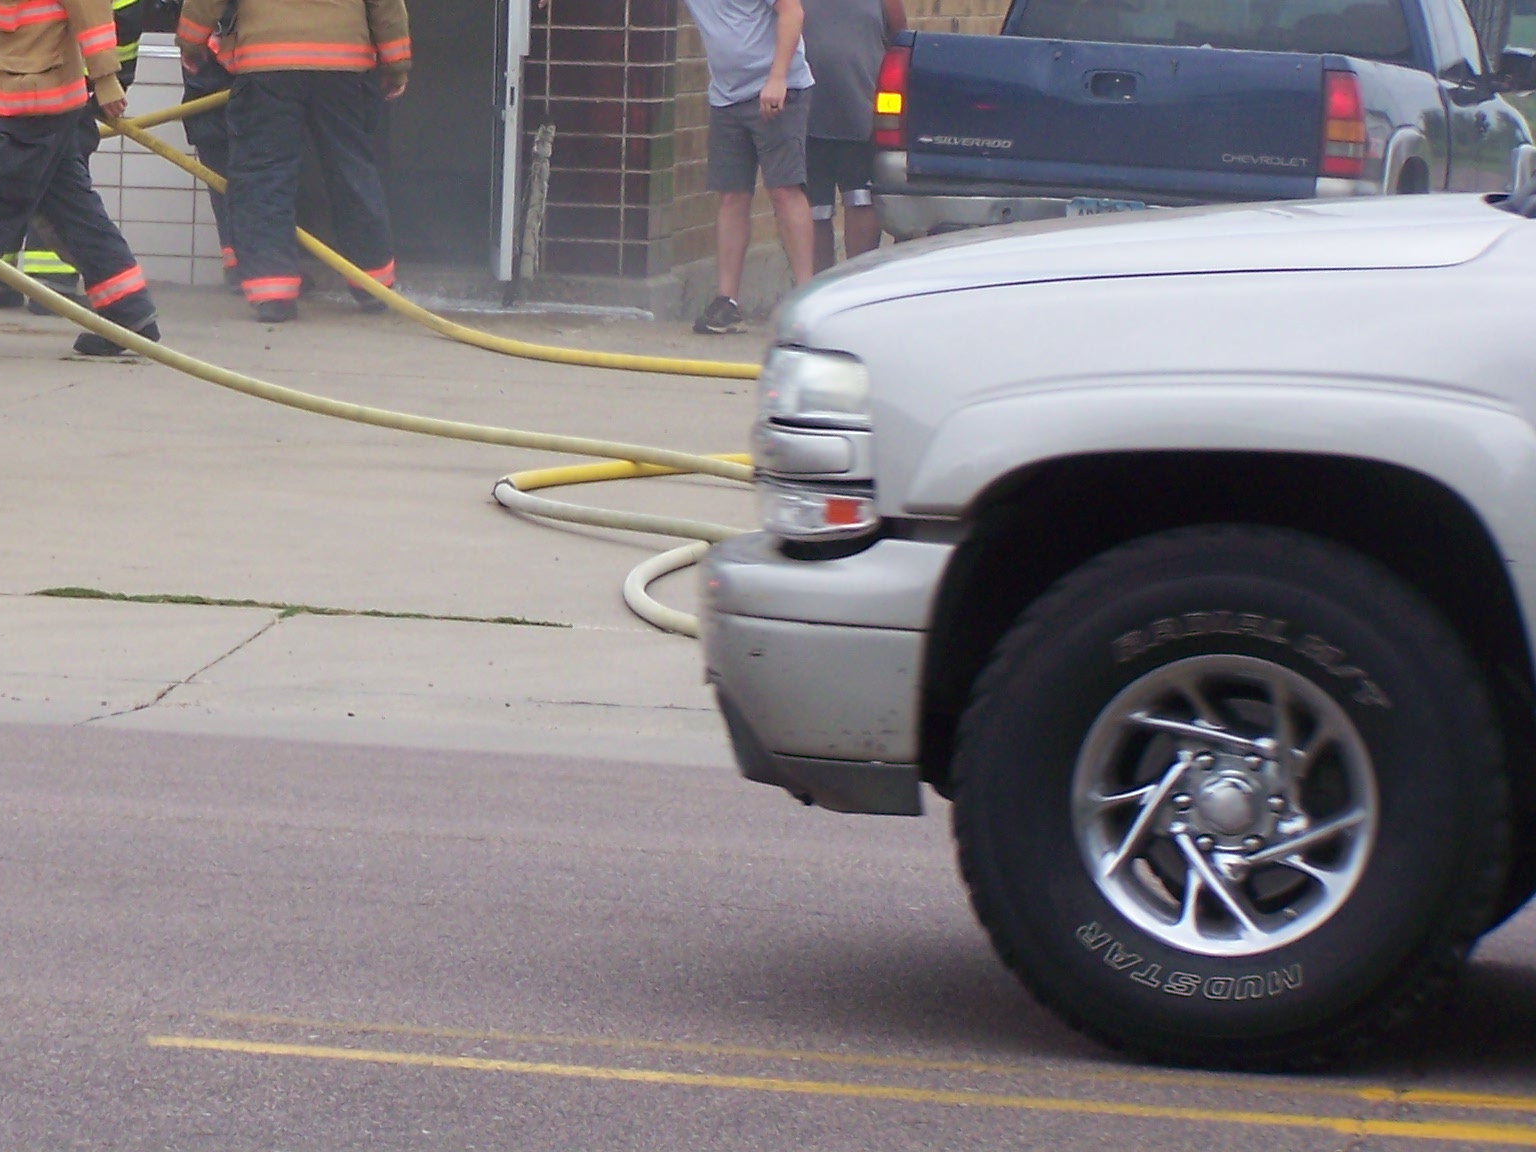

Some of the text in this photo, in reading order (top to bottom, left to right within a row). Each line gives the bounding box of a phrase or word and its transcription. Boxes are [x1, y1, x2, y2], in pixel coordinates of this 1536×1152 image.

[932, 134, 1014, 149] SILVERADO
[1221, 152, 1310, 168] CHEVROLET
[1075, 920, 1304, 1001] MUDSTAR
